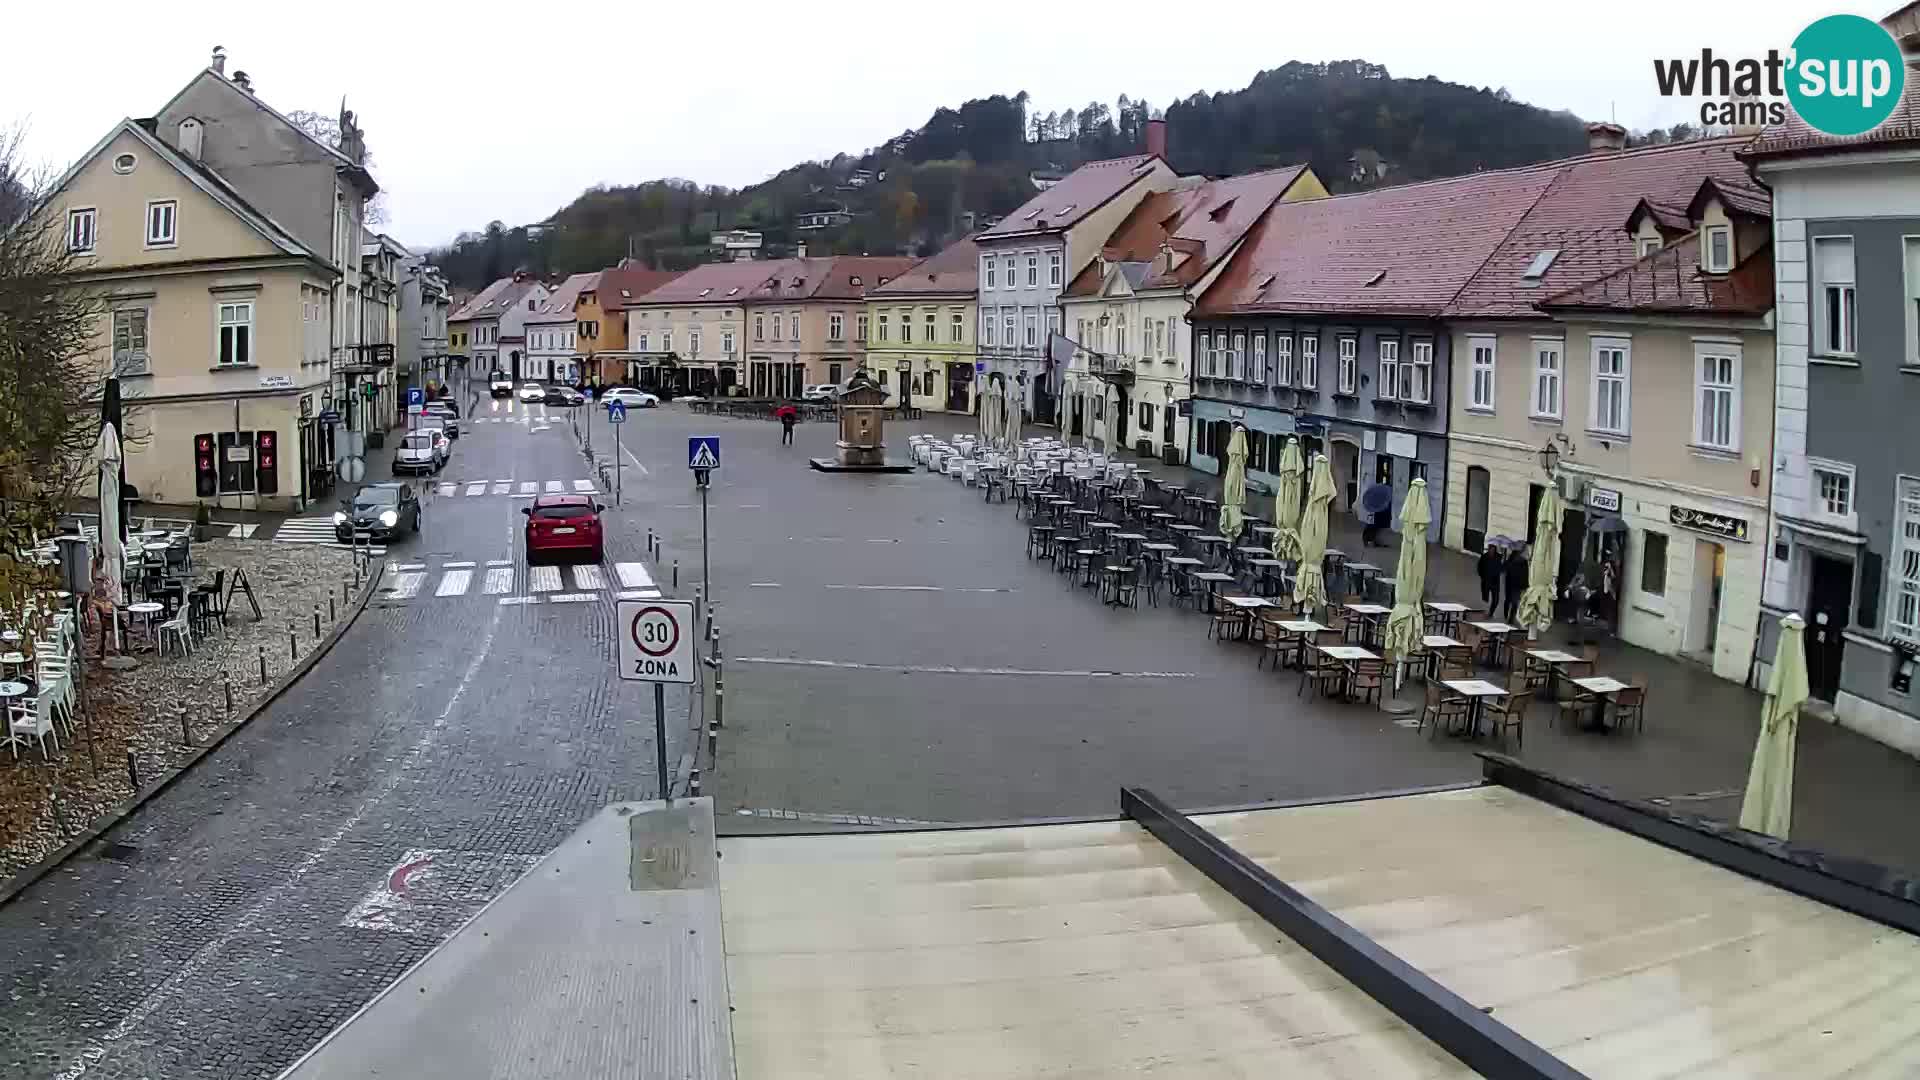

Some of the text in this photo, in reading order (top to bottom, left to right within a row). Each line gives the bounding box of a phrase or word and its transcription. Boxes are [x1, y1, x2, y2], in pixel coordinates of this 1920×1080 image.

[411, 391, 420, 402] P
[644, 622, 668, 643] 30
[635, 659, 678, 677] ZONA
